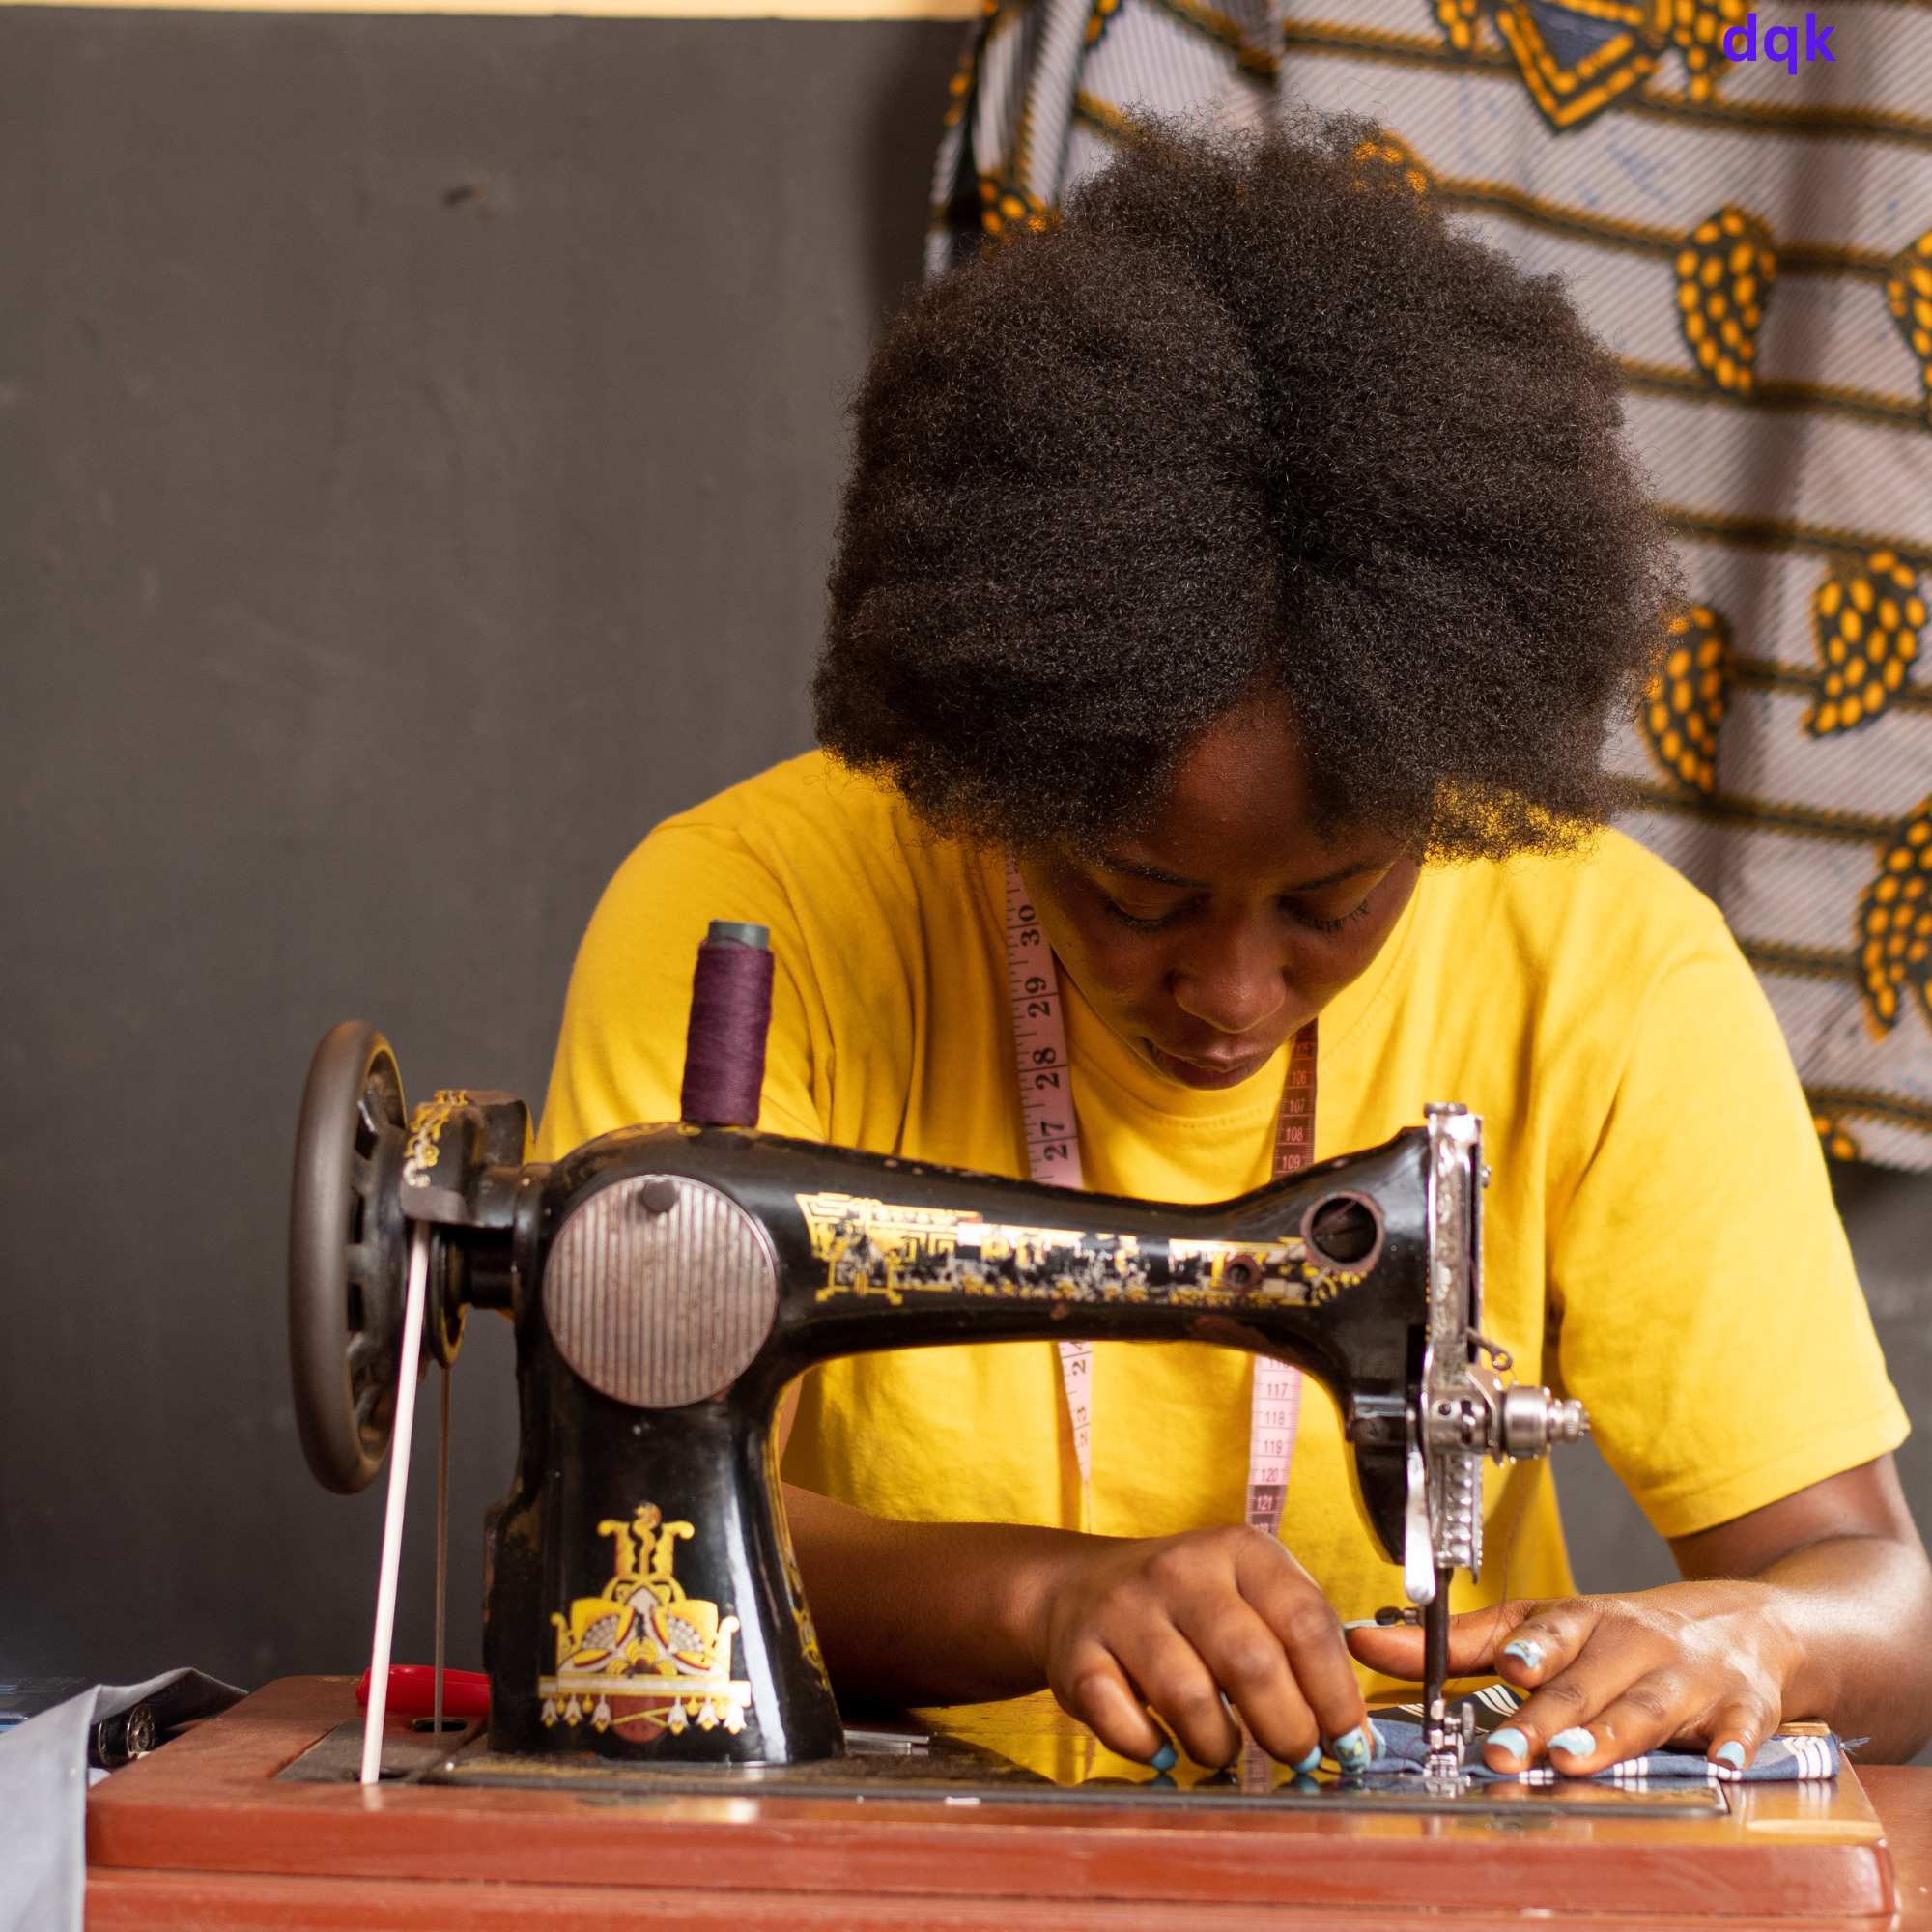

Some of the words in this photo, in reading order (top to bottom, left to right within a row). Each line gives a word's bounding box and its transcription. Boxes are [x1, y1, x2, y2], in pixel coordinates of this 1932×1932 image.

[1018, 904, 1041, 947] 30
[1025, 976, 1051, 1019] 29
[1033, 1047, 1060, 1091] 28
[1293, 1070, 1307, 1086] 106
[1290, 1099, 1306, 1114] 107
[1041, 1121, 1068, 1162] 27
[1286, 1127, 1303, 1142] 108
[1283, 1155, 1301, 1170] 109
[1267, 1383, 1289, 1397] 117
[1265, 1411, 1285, 1426] 118
[1264, 1439, 1283, 1454] 119
[1262, 1467, 1279, 1483] 120
[1257, 1495, 1273, 1511] 121
